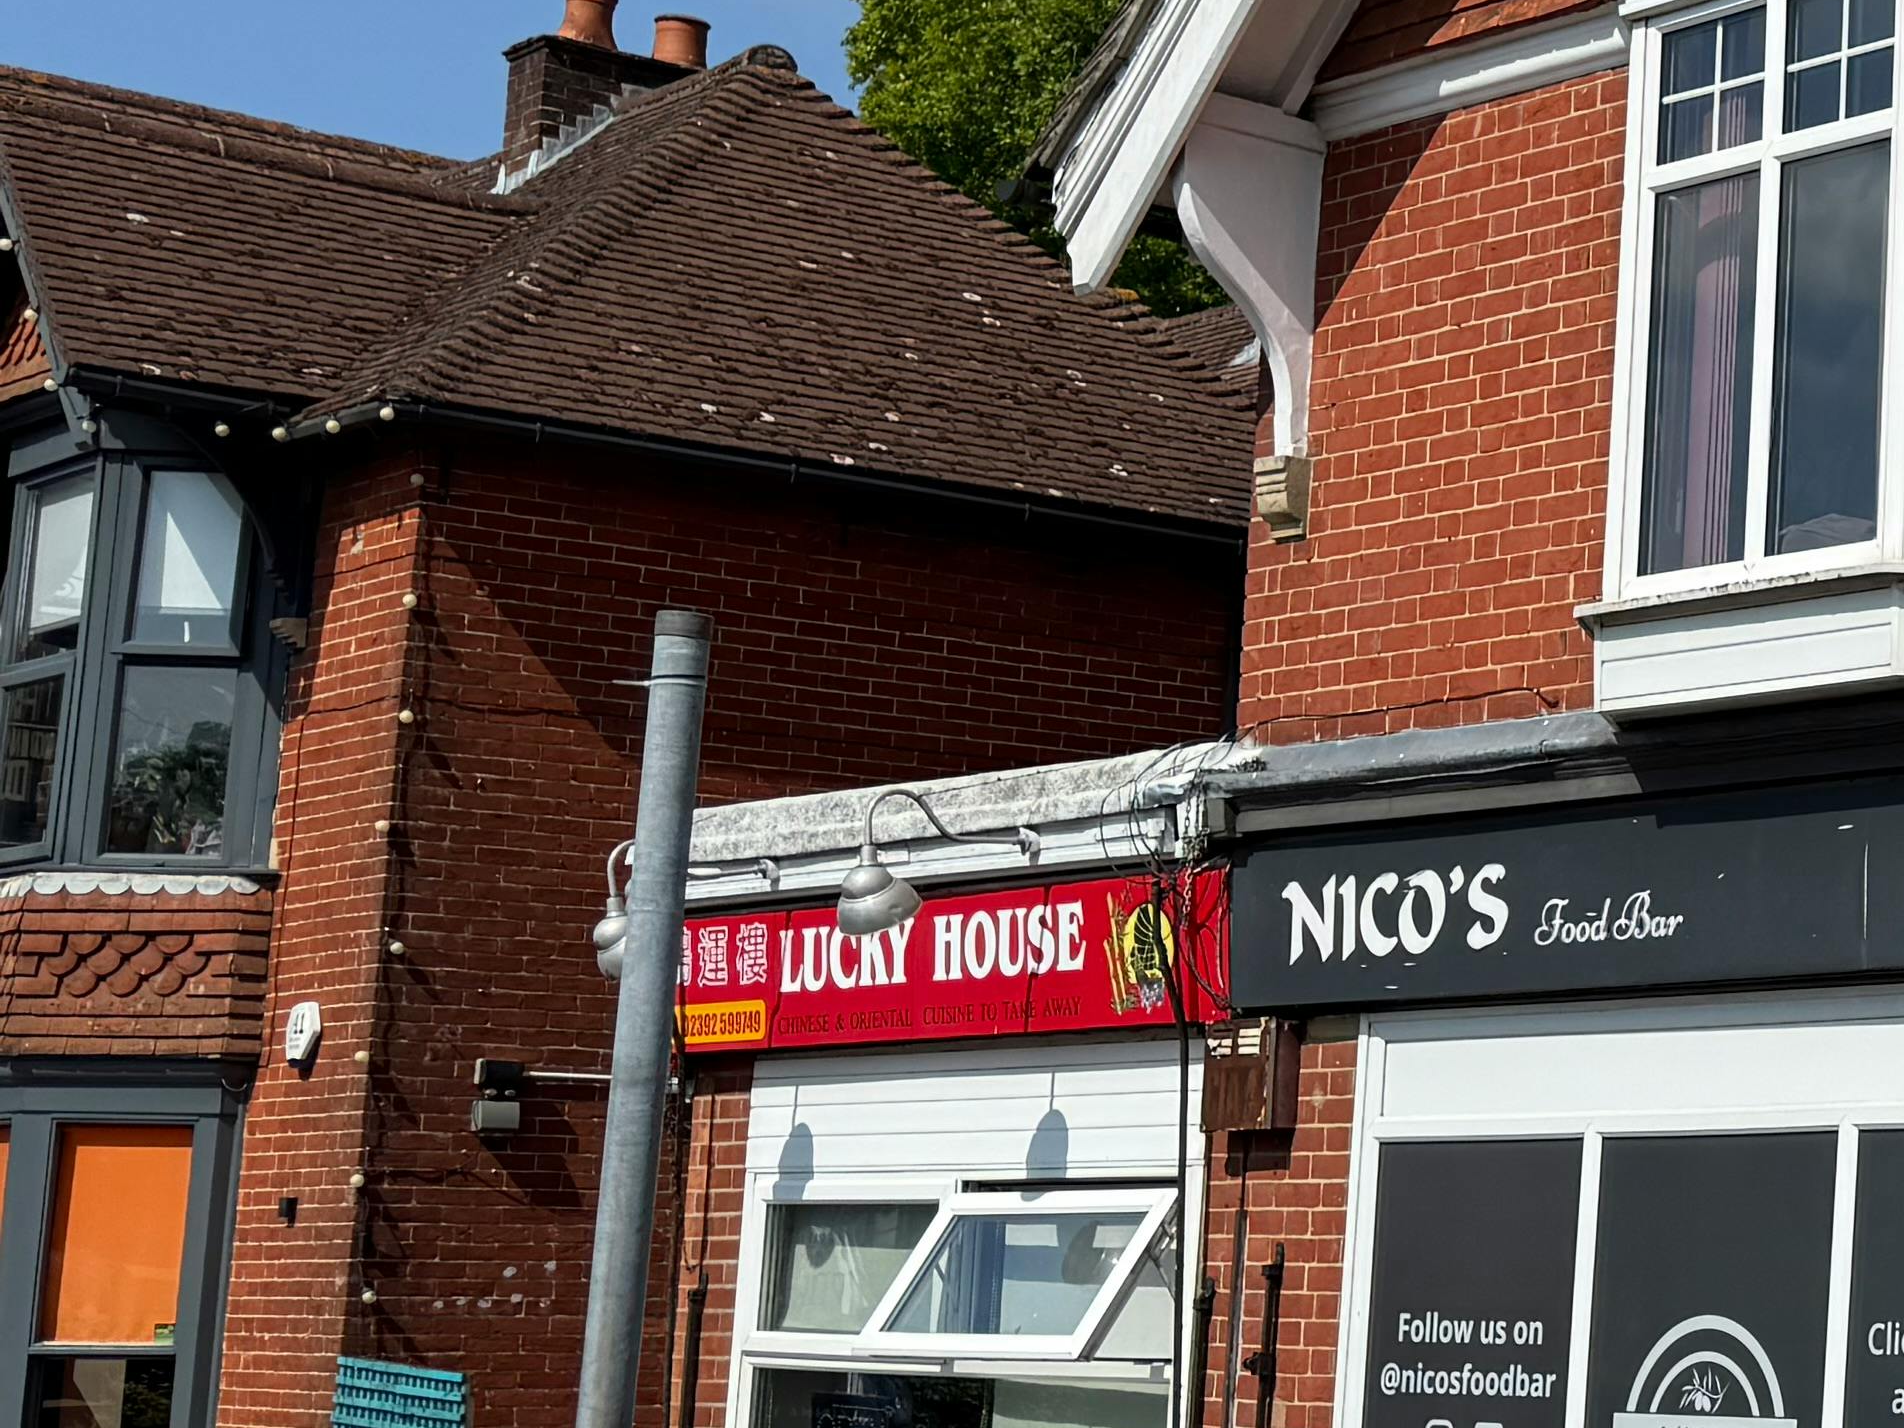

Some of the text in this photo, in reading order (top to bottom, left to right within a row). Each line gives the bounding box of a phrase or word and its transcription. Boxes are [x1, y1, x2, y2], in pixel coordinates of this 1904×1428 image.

[1281, 863, 1684, 966] NICO'S Food Bar
[778, 899, 1087, 993] LUCKY HOUSE
[719, 1010, 762, 1035] 599749
[777, 1014, 830, 1036] CHINESE
[835, 1011, 846, 1032] &
[850, 1008, 913, 1030] ORIENTAL
[923, 1002, 974, 1025] CUISINE
[981, 1002, 998, 1022] TO
[1043, 996, 1082, 1017] AWAY
[1398, 1311, 1544, 1346] Follow us on
[1380, 1362, 1557, 1399] @nicosfoodbar
